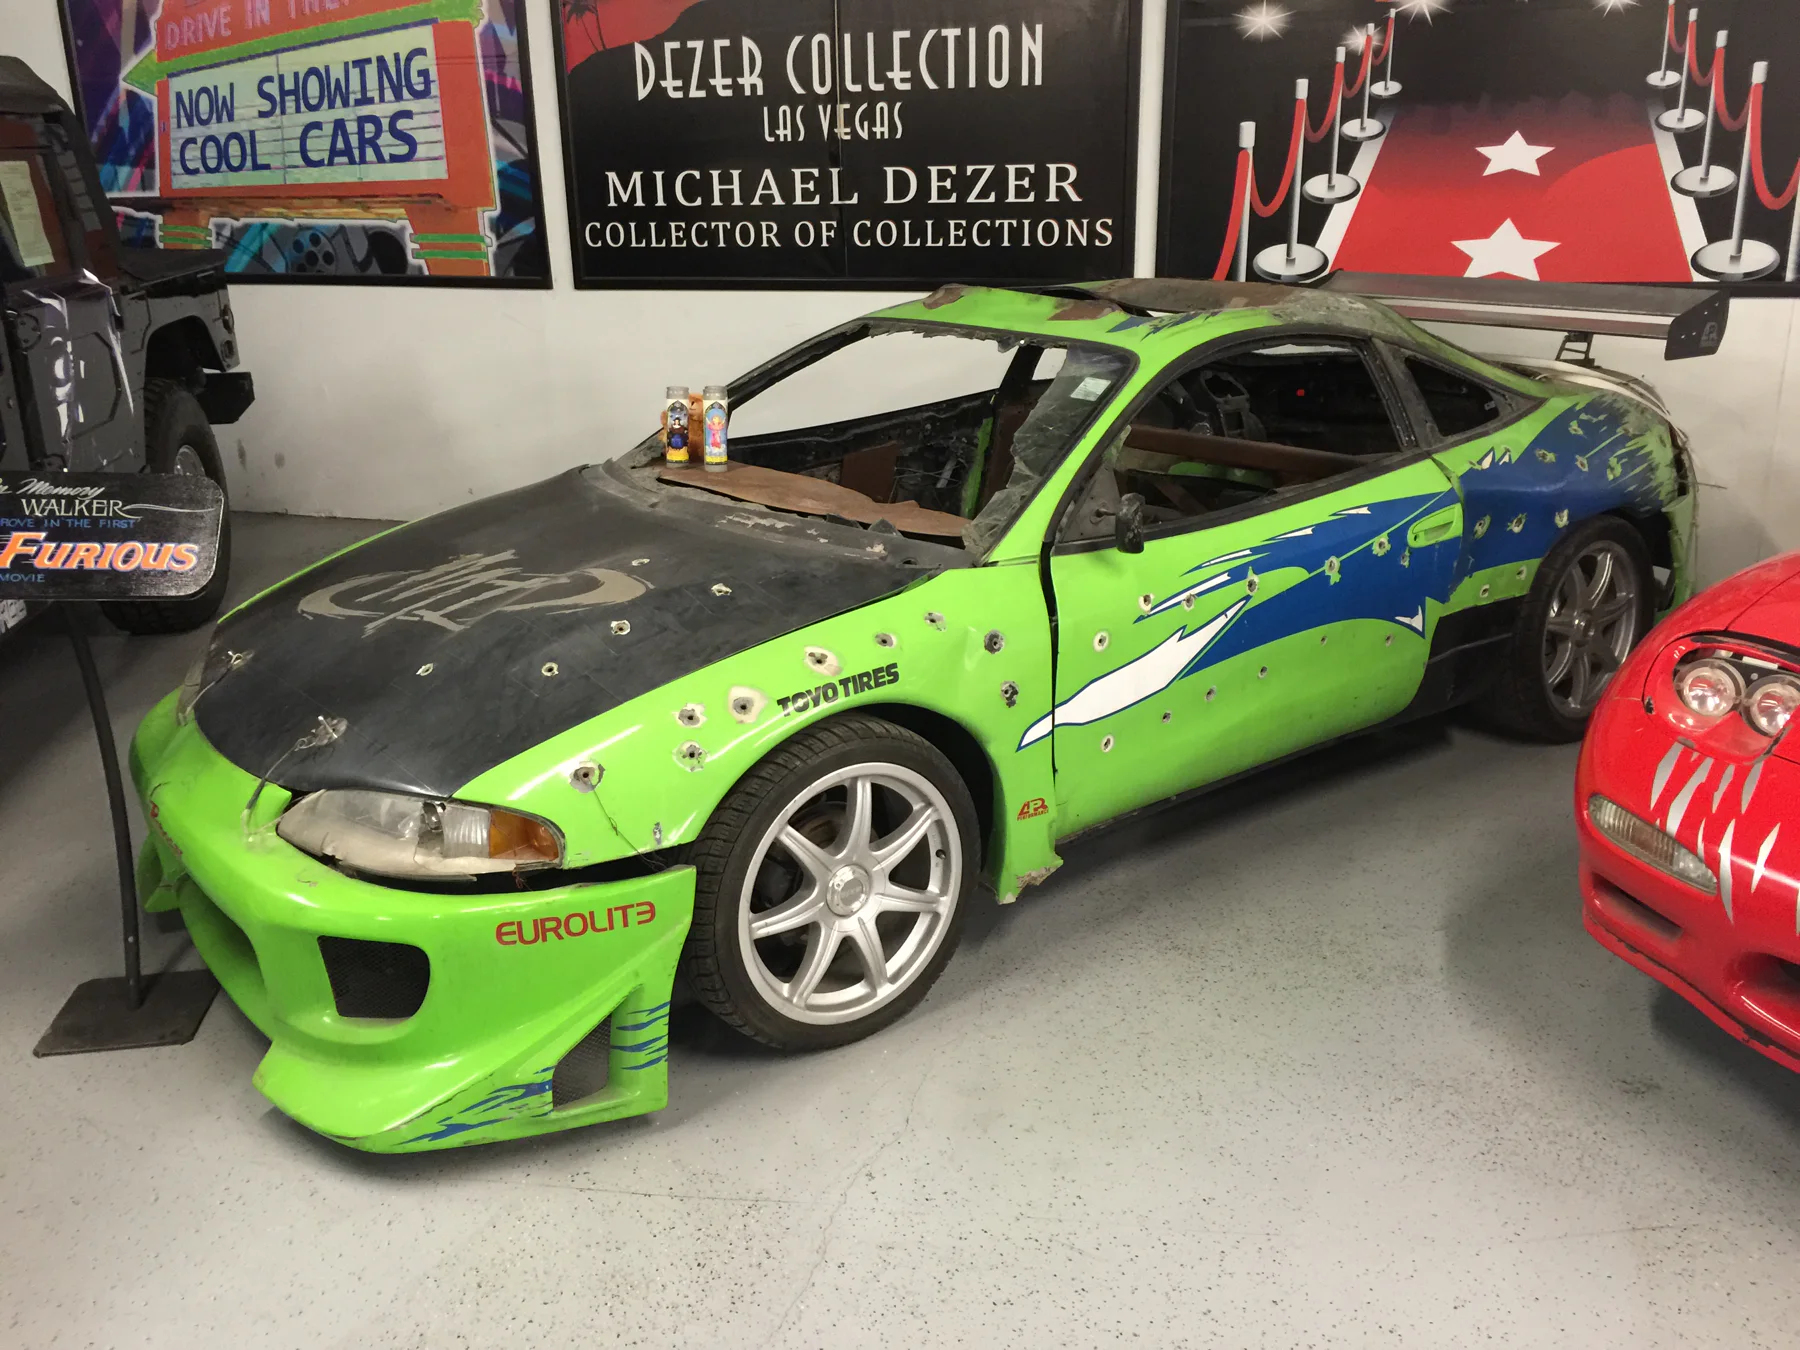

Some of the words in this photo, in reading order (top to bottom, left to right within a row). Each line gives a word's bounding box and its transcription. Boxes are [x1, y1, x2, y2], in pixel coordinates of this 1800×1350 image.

[165, 4, 232, 50] DRIVE
[244, 0, 271, 29] IN
[634, 36, 764, 100] DEZER
[785, 23, 1043, 95] COLLECTION
[175, 82, 235, 128] NOW
[257, 47, 432, 118] SHOWING
[179, 130, 272, 175] COOL
[299, 110, 418, 167] CARS
[763, 105, 804, 142] LAS
[819, 101, 903, 140] VEGAS
[605, 167, 860, 207] MICHAEL
[884, 163, 1083, 204] DEZER
[585, 222, 782, 248] COLLECTOR
[794, 221, 838, 248] OF
[852, 218, 1114, 248] COLLECTIONS
[16, 478, 105, 500] Memory
[21, 498, 142, 518] WALKER
[0, 518, 35, 528] ROVE
[44, 519, 60, 528] IN
[66, 518, 92, 528] THE
[99, 518, 136, 529] FIRST
[0, 531, 199, 571] FURIOUS
[777, 682, 839, 717] TOYO
[838, 662, 900, 698] TIRES
